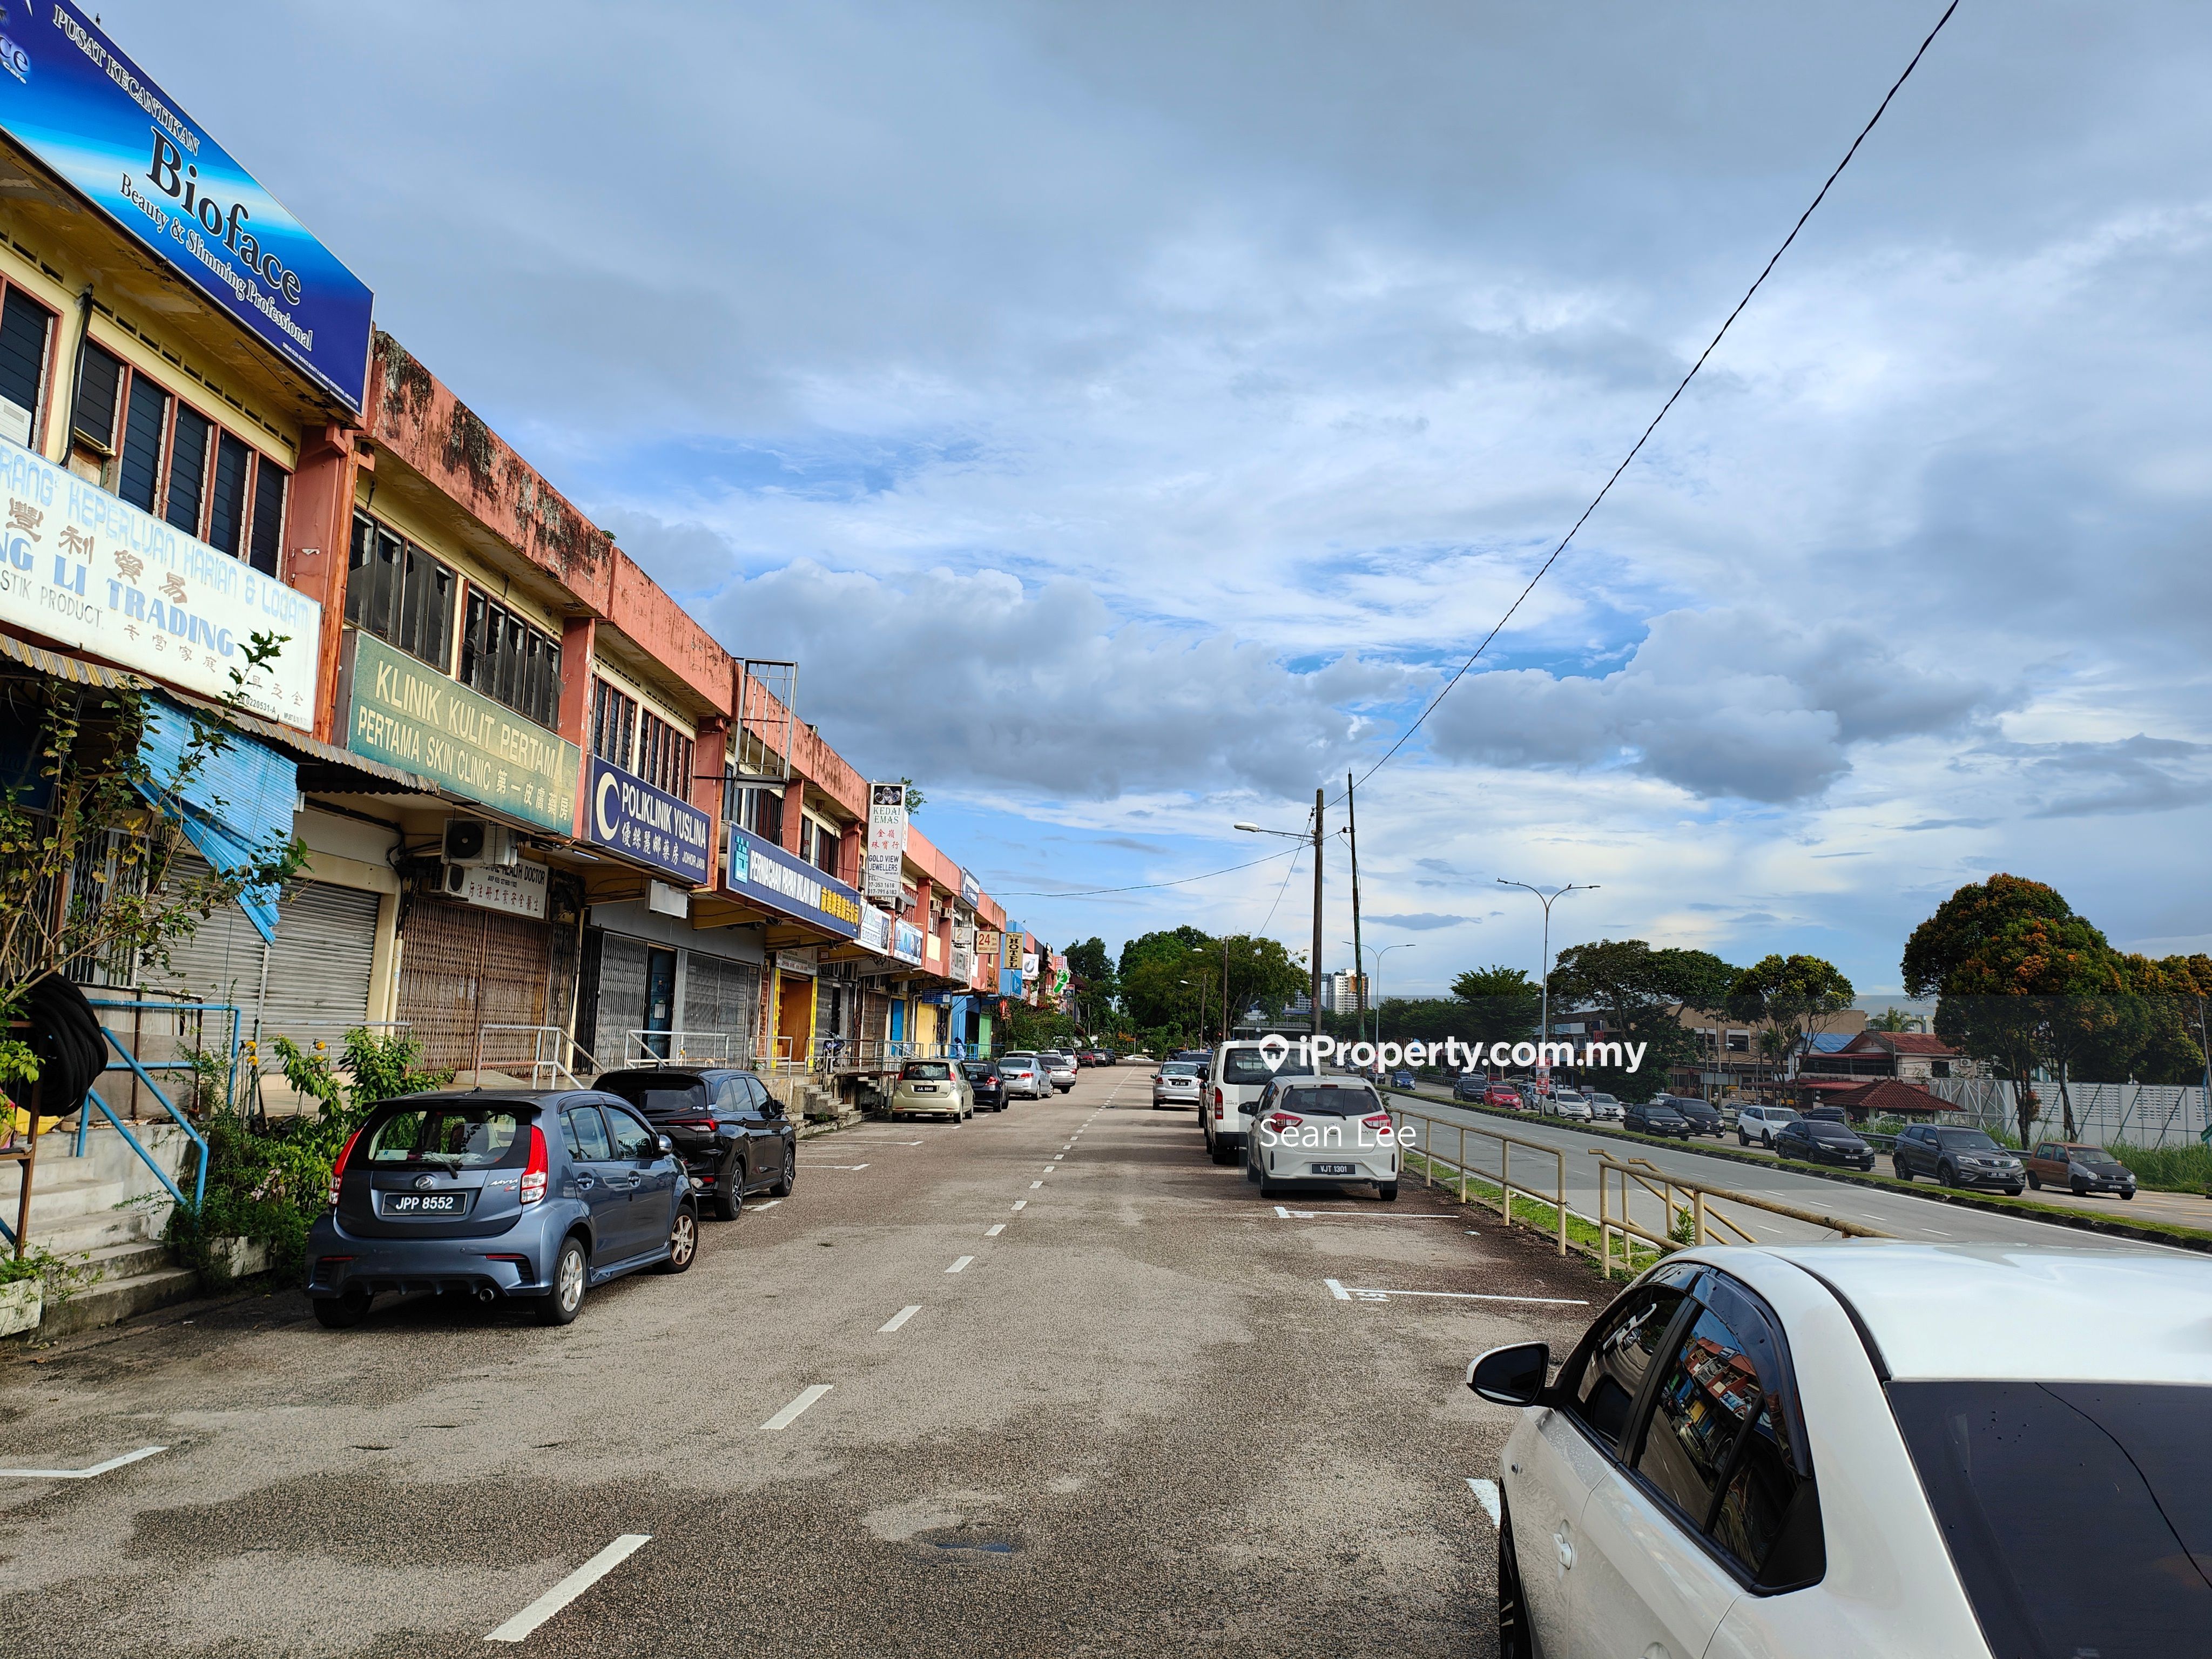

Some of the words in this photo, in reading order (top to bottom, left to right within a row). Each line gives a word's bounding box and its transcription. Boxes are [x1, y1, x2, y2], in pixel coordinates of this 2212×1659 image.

[53, 4, 106, 68] PUSAT
[106, 55, 200, 157] KECANTIKAN
[146, 126, 301, 306] Bioface
[120, 172, 168, 233] Beauty
[171, 217, 185, 244] &
[186, 228, 246, 301] Slimming
[246, 279, 313, 352] Professional
[68, 481, 176, 570] KEPERLUAN
[183, 541, 238, 599] HARIAN
[245, 575, 256, 606] &
[54, 554, 86, 597] LI
[106, 577, 234, 658] TRADING
[246, 697, 276, 714] 0220531-A
[375, 660, 442, 726] KLINIK
[448, 696, 495, 749] KULIT
[500, 724, 565, 783] PERTAMA
[358, 705, 420, 763] PERTAMA
[426, 736, 454, 775] SKIN
[457, 750, 491, 791] CLINIC
[622, 781, 672, 834] POLIKLINIK
[673, 808, 706, 850] YUSLINA
[873, 807, 900, 815] KEDAI
[874, 815, 899, 824] EMAS
[682, 851, 697, 868] JOHOR
[868, 854, 883, 862] GOLD
[885, 855, 899, 863] VIEW
[524, 866, 545, 886] DOCTOR
[979, 933, 990, 946] 24
[1008, 938, 1019, 968] HOTEL
[395, 1197, 420, 1210] JPP
[421, 1196, 454, 1210] 8552
